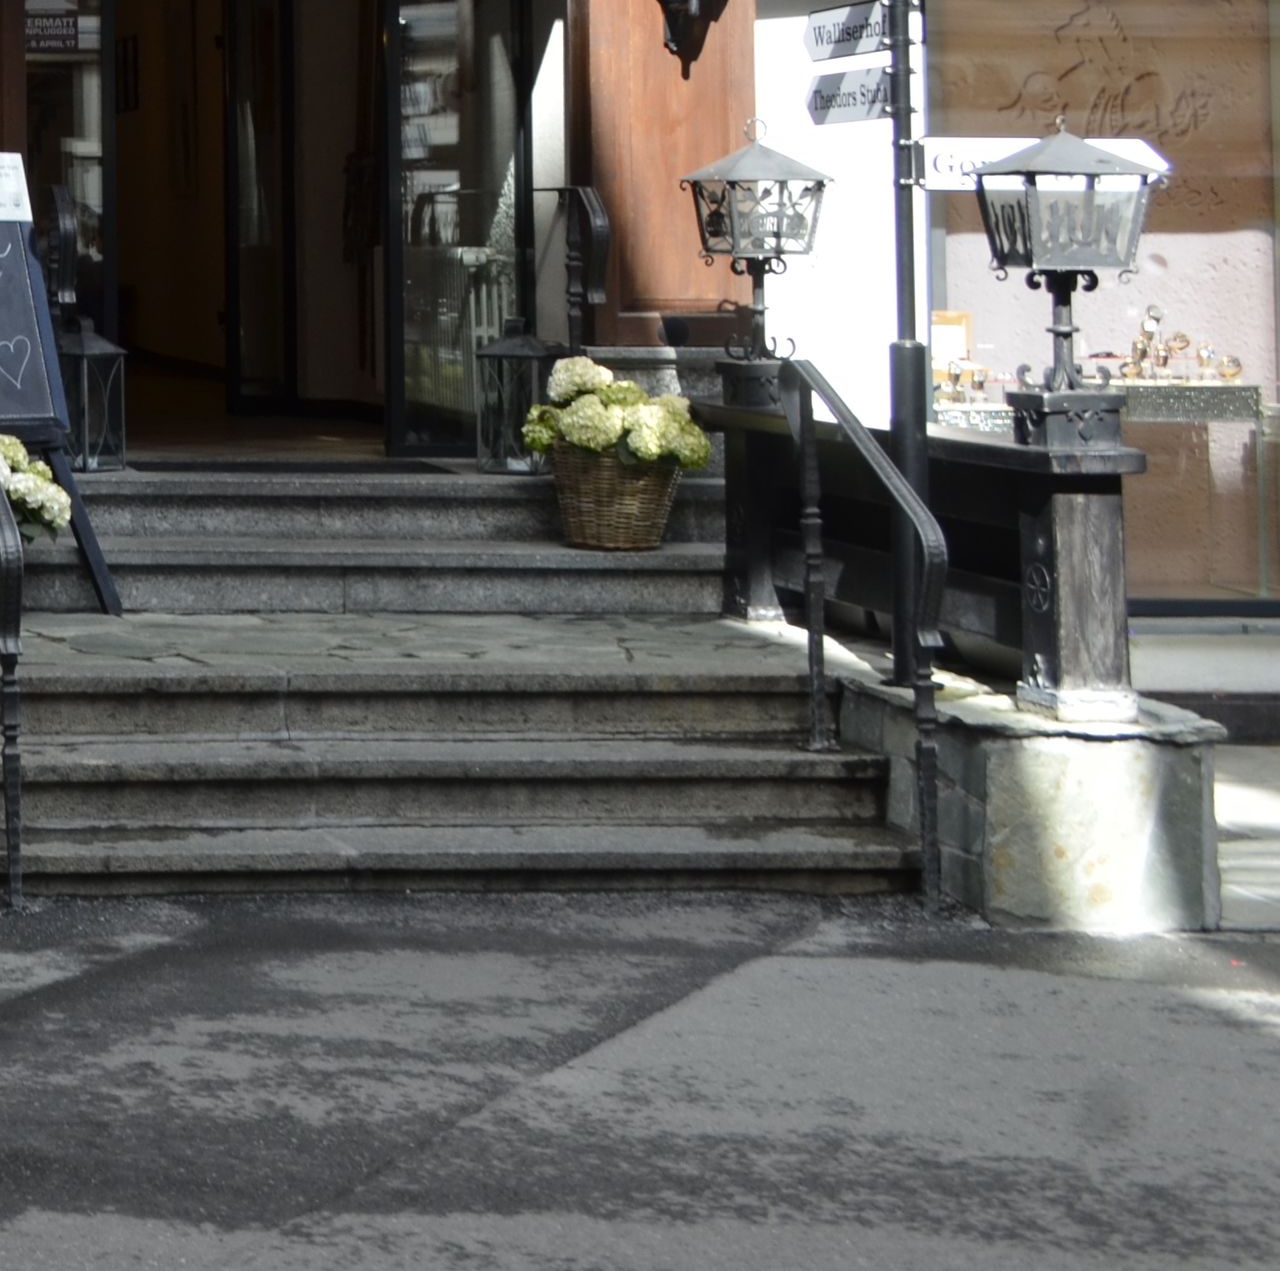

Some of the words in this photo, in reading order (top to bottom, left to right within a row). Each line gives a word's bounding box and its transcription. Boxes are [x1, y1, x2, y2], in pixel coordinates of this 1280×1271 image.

[27, 17, 75, 27] ERMATT
[25, 27, 75, 35] NPLUGGED
[813, 14, 887, 47] Walliserhof
[39, 40, 64, 48] APRIL
[814, 86, 857, 111] Theodors
[860, 82, 888, 105] Stuba
